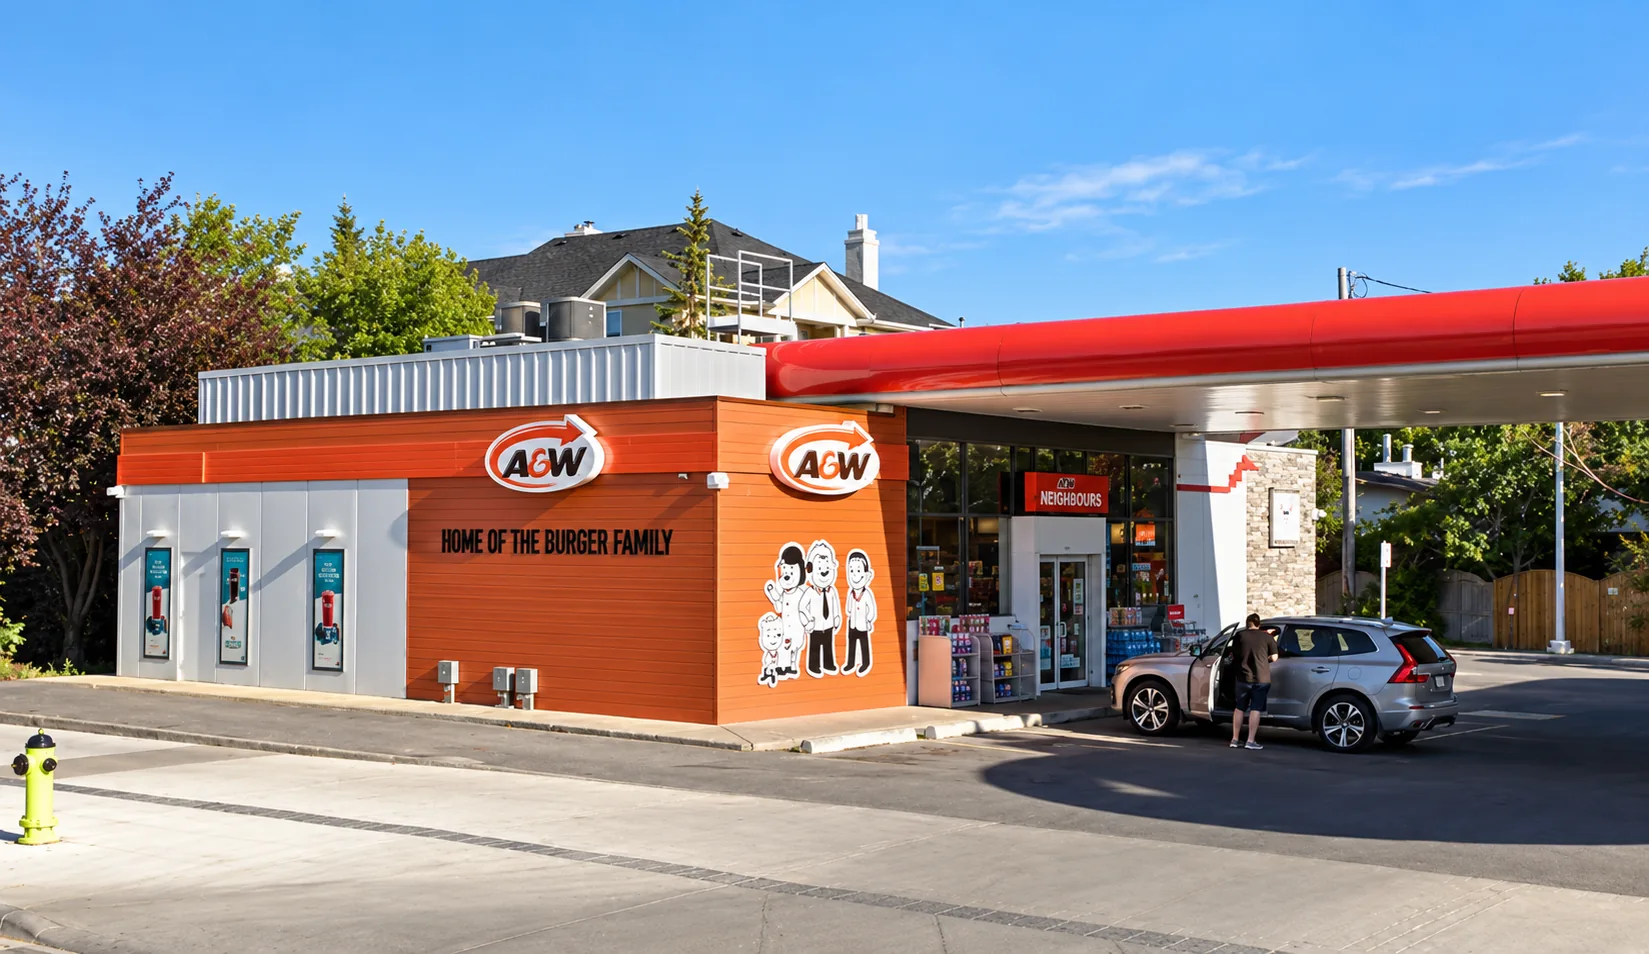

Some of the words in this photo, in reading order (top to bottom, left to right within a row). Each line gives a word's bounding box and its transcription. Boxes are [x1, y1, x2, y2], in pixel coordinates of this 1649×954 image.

[502, 446, 587, 478] A&W
[794, 449, 871, 481] A&W
[1040, 490, 1102, 507] NEIGHBOURS
[441, 528, 484, 554] HOME
[487, 528, 508, 554] OF
[510, 528, 540, 555] THE
[545, 528, 608, 555] BURGER
[613, 529, 673, 556] FAMILY
